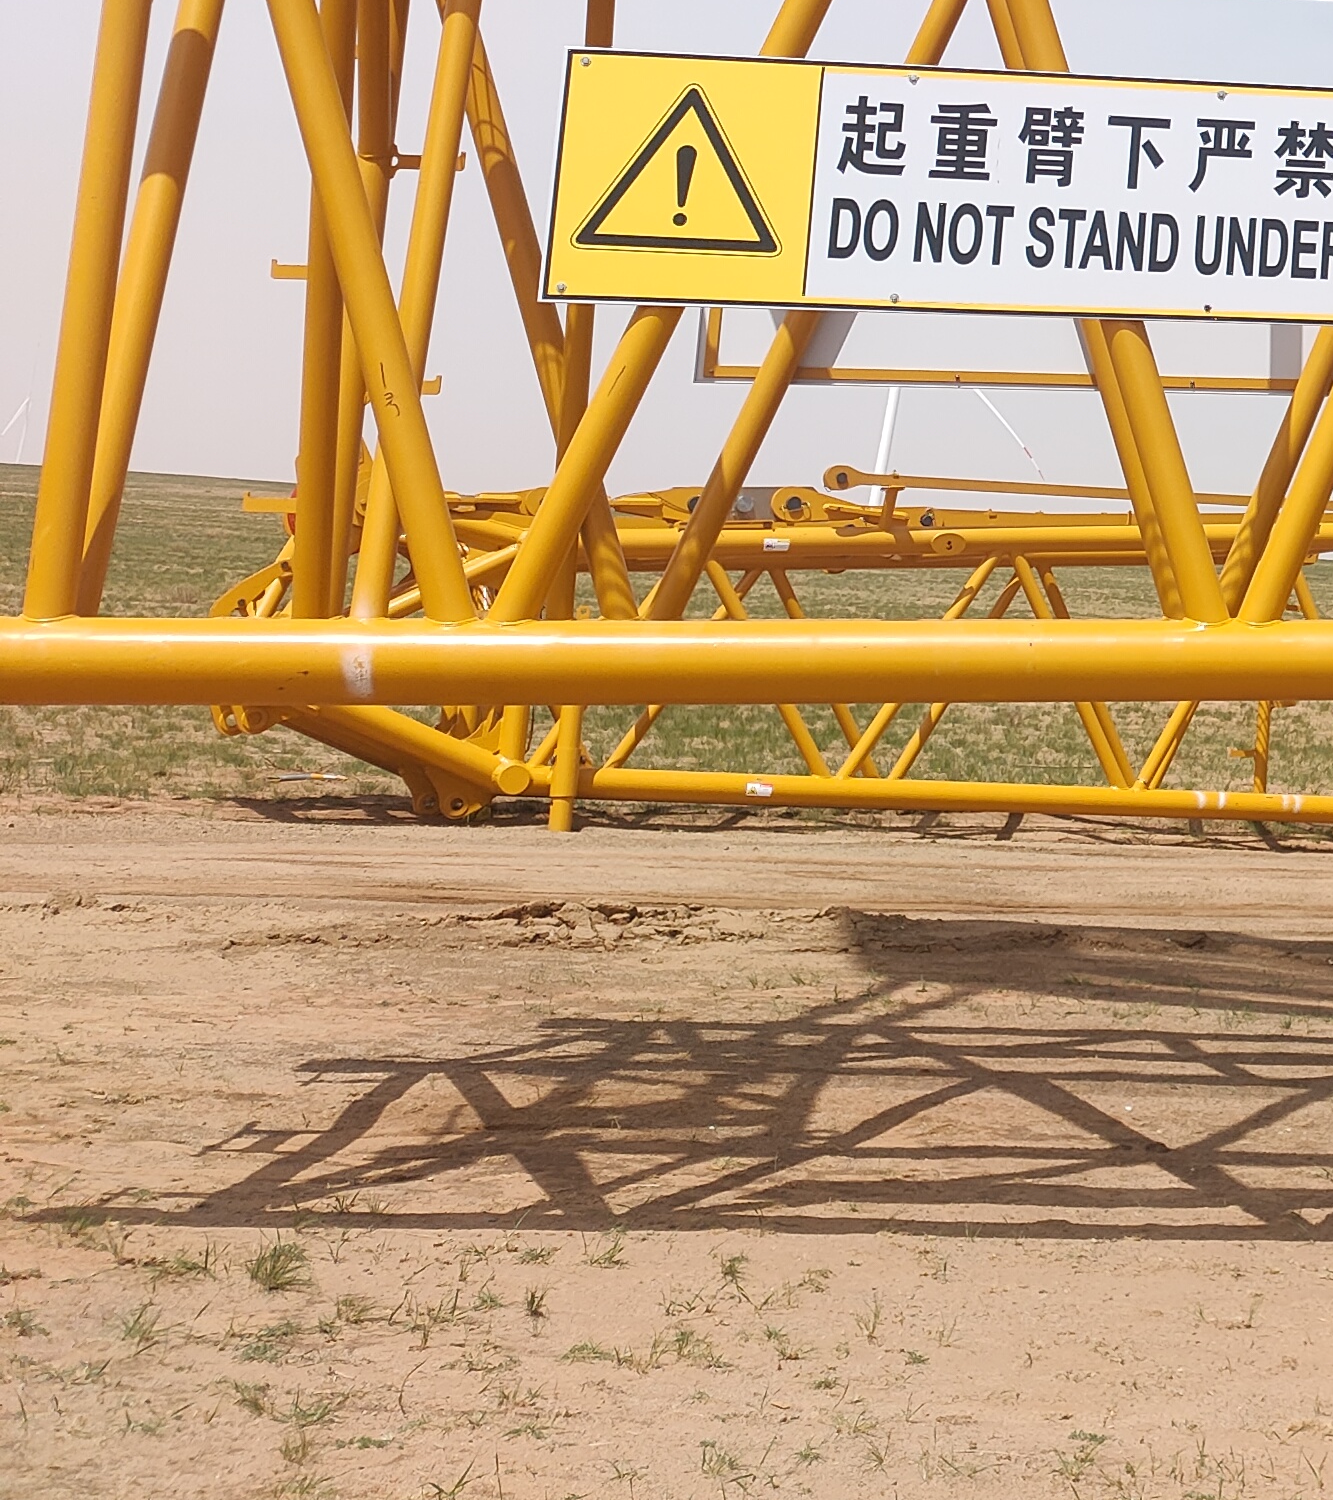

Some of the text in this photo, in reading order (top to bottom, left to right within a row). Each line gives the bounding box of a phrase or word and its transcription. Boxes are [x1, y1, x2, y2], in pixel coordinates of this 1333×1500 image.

[826, 196, 900, 263] DO
[912, 200, 1016, 267] NOT
[1024, 205, 1180, 274] STAND
